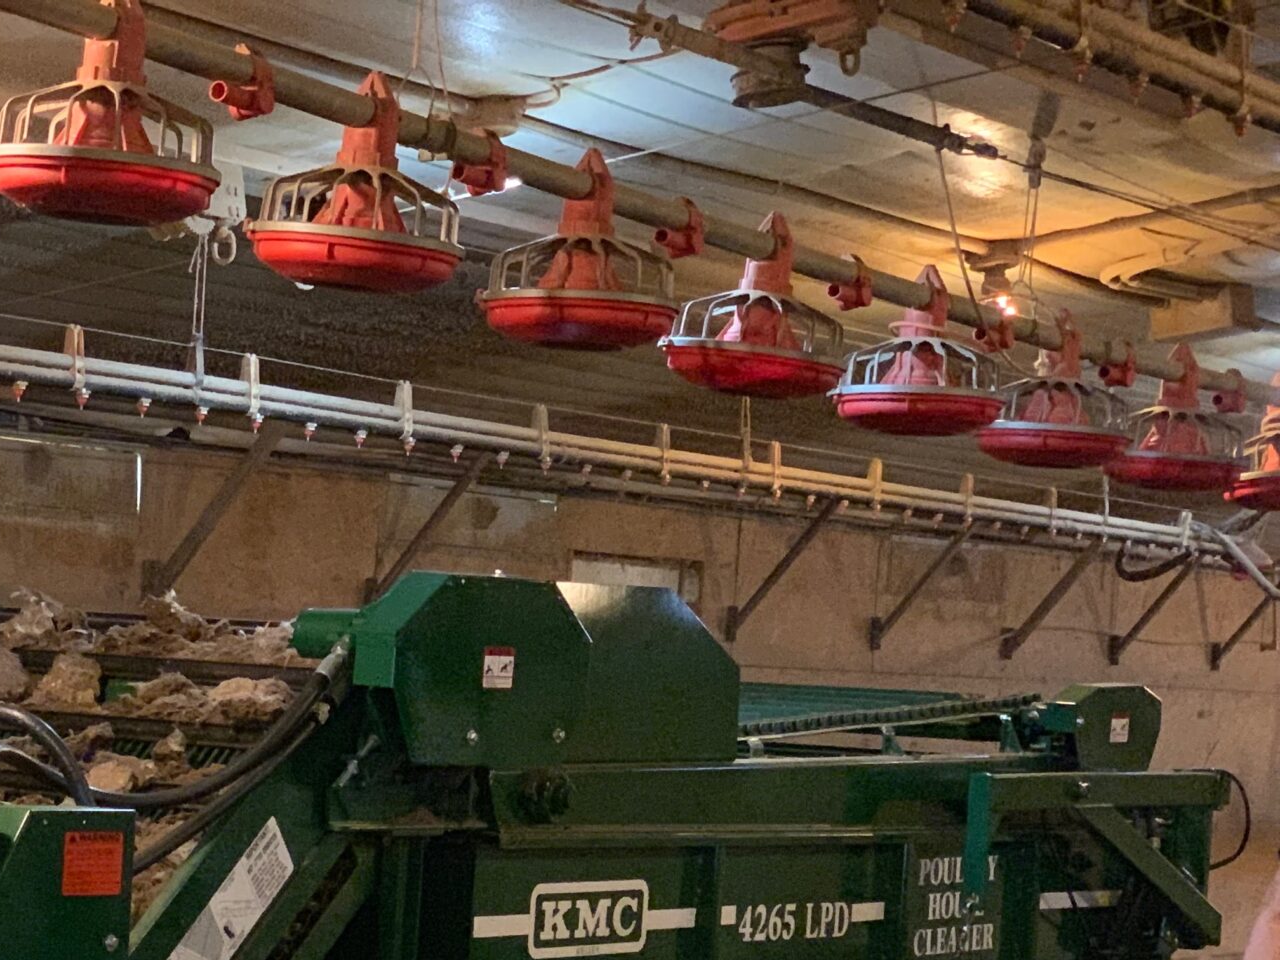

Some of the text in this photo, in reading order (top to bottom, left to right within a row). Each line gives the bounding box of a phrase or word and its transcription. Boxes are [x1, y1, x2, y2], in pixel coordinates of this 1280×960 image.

[918, 855, 999, 886] POULY
[540, 896, 638, 941] KMC
[738, 902, 849, 942] 4265 LPD
